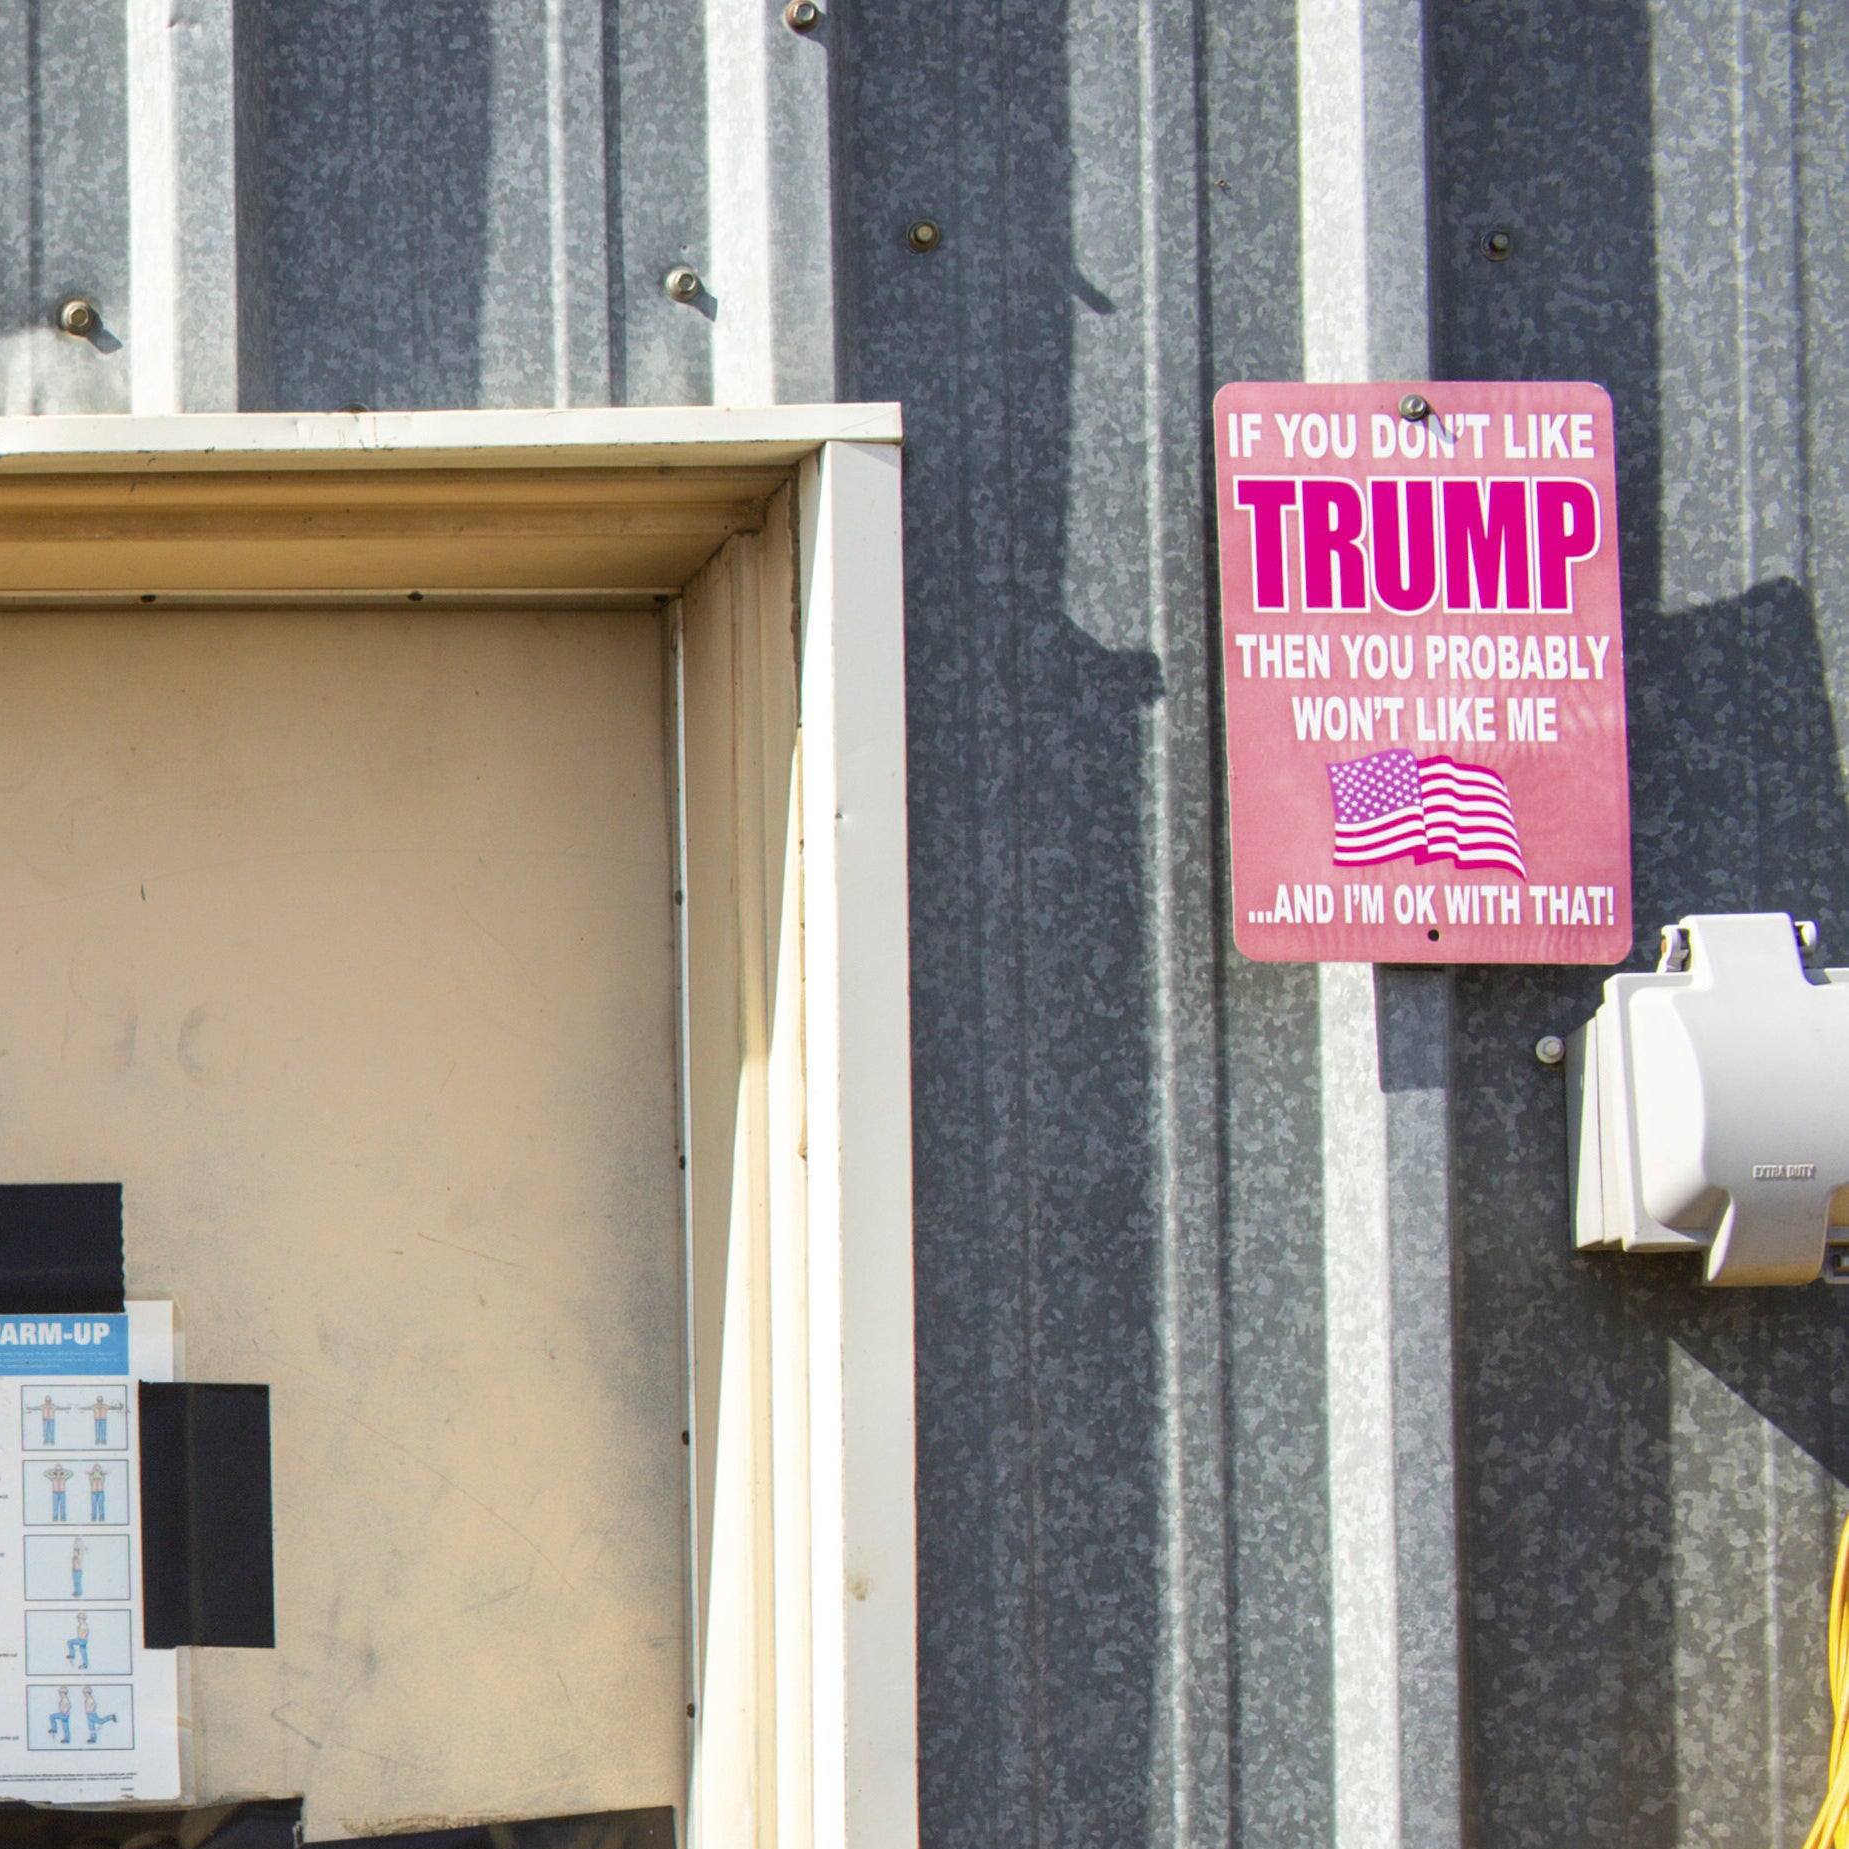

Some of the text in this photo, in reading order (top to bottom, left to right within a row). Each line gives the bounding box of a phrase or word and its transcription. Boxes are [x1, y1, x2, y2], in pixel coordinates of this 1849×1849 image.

[1228, 413, 1595, 459] IF YOU DON'T LIKE
[1232, 475, 1602, 616] TRUMP
[1236, 634, 1610, 680] THEN YOU PROBABLY
[1292, 696, 1559, 743] WON'T LIKE ME
[1344, 884, 1385, 924] I'M
[1393, 884, 1436, 924] OK
[1444, 885, 1521, 925] WITH
[1530, 886, 1615, 926] THAT!
